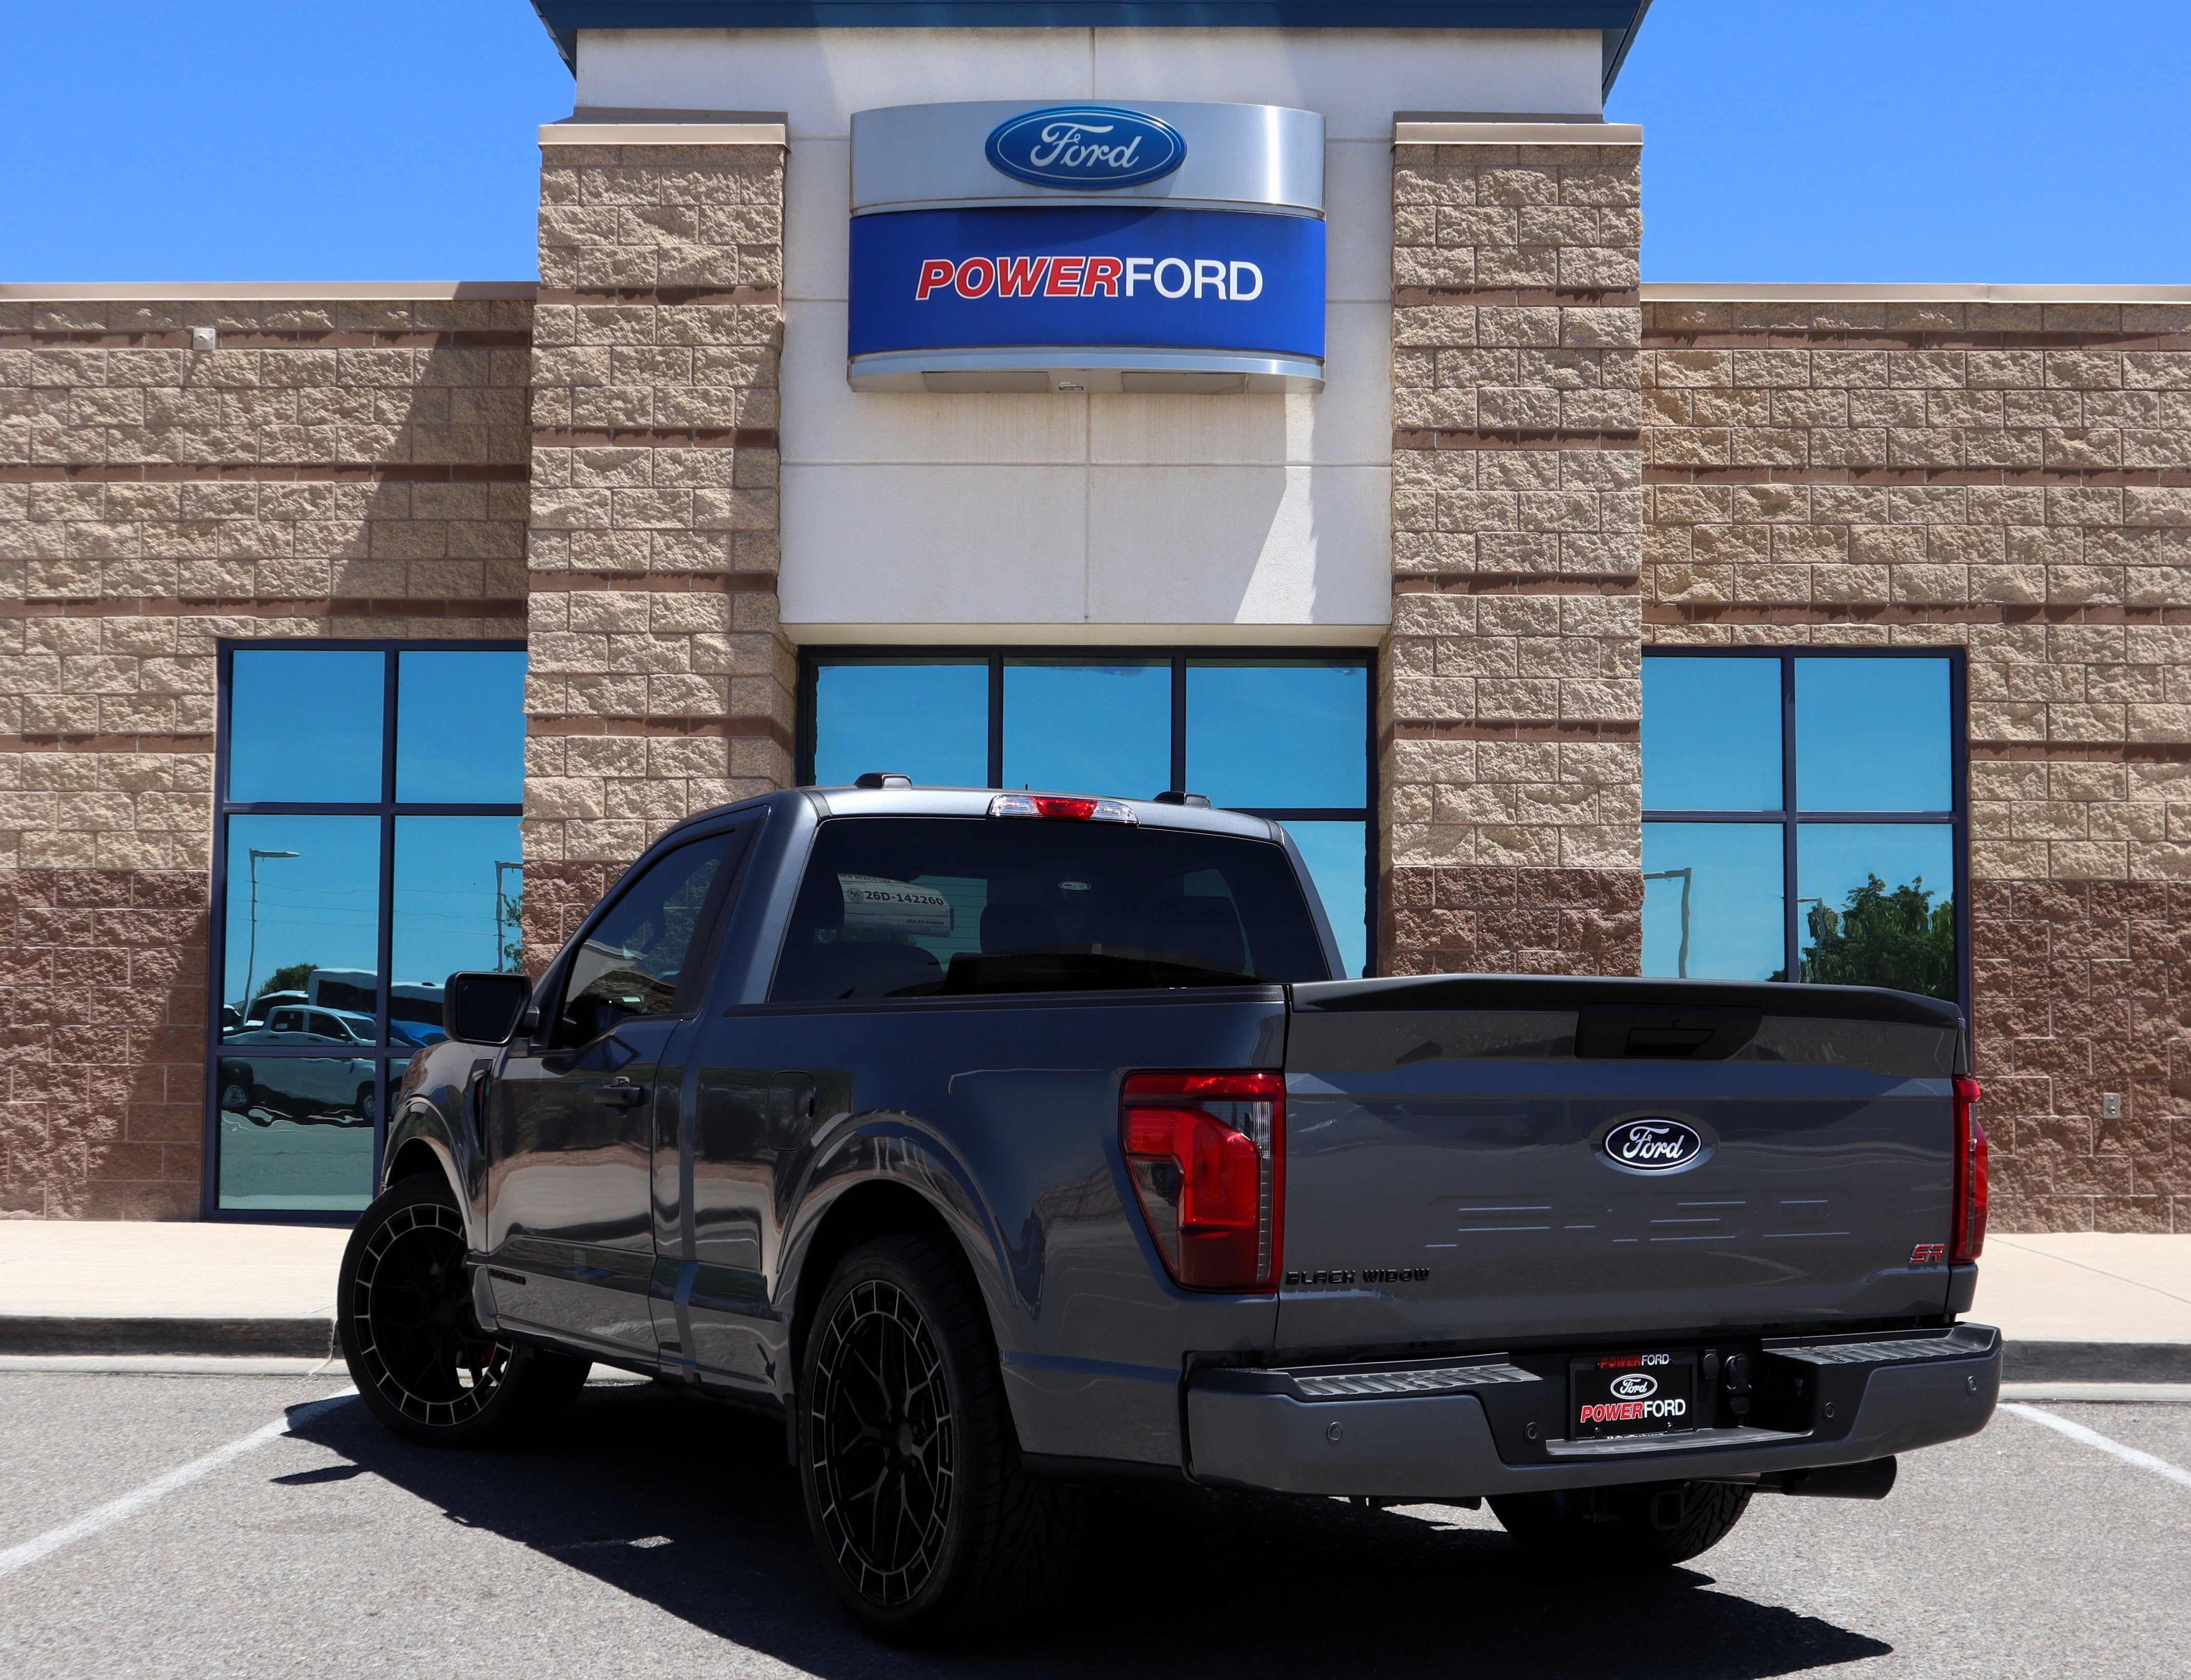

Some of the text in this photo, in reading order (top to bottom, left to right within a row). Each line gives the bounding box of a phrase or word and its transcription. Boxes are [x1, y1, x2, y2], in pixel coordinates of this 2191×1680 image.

[1030, 122, 1142, 168] Ford
[864, 890, 944, 906] 26D-142260
[1622, 1126, 1685, 1159] Ford
[1285, 1267, 1431, 1286] BLACK WIDOW
[1619, 1378, 1648, 1395] Ford
